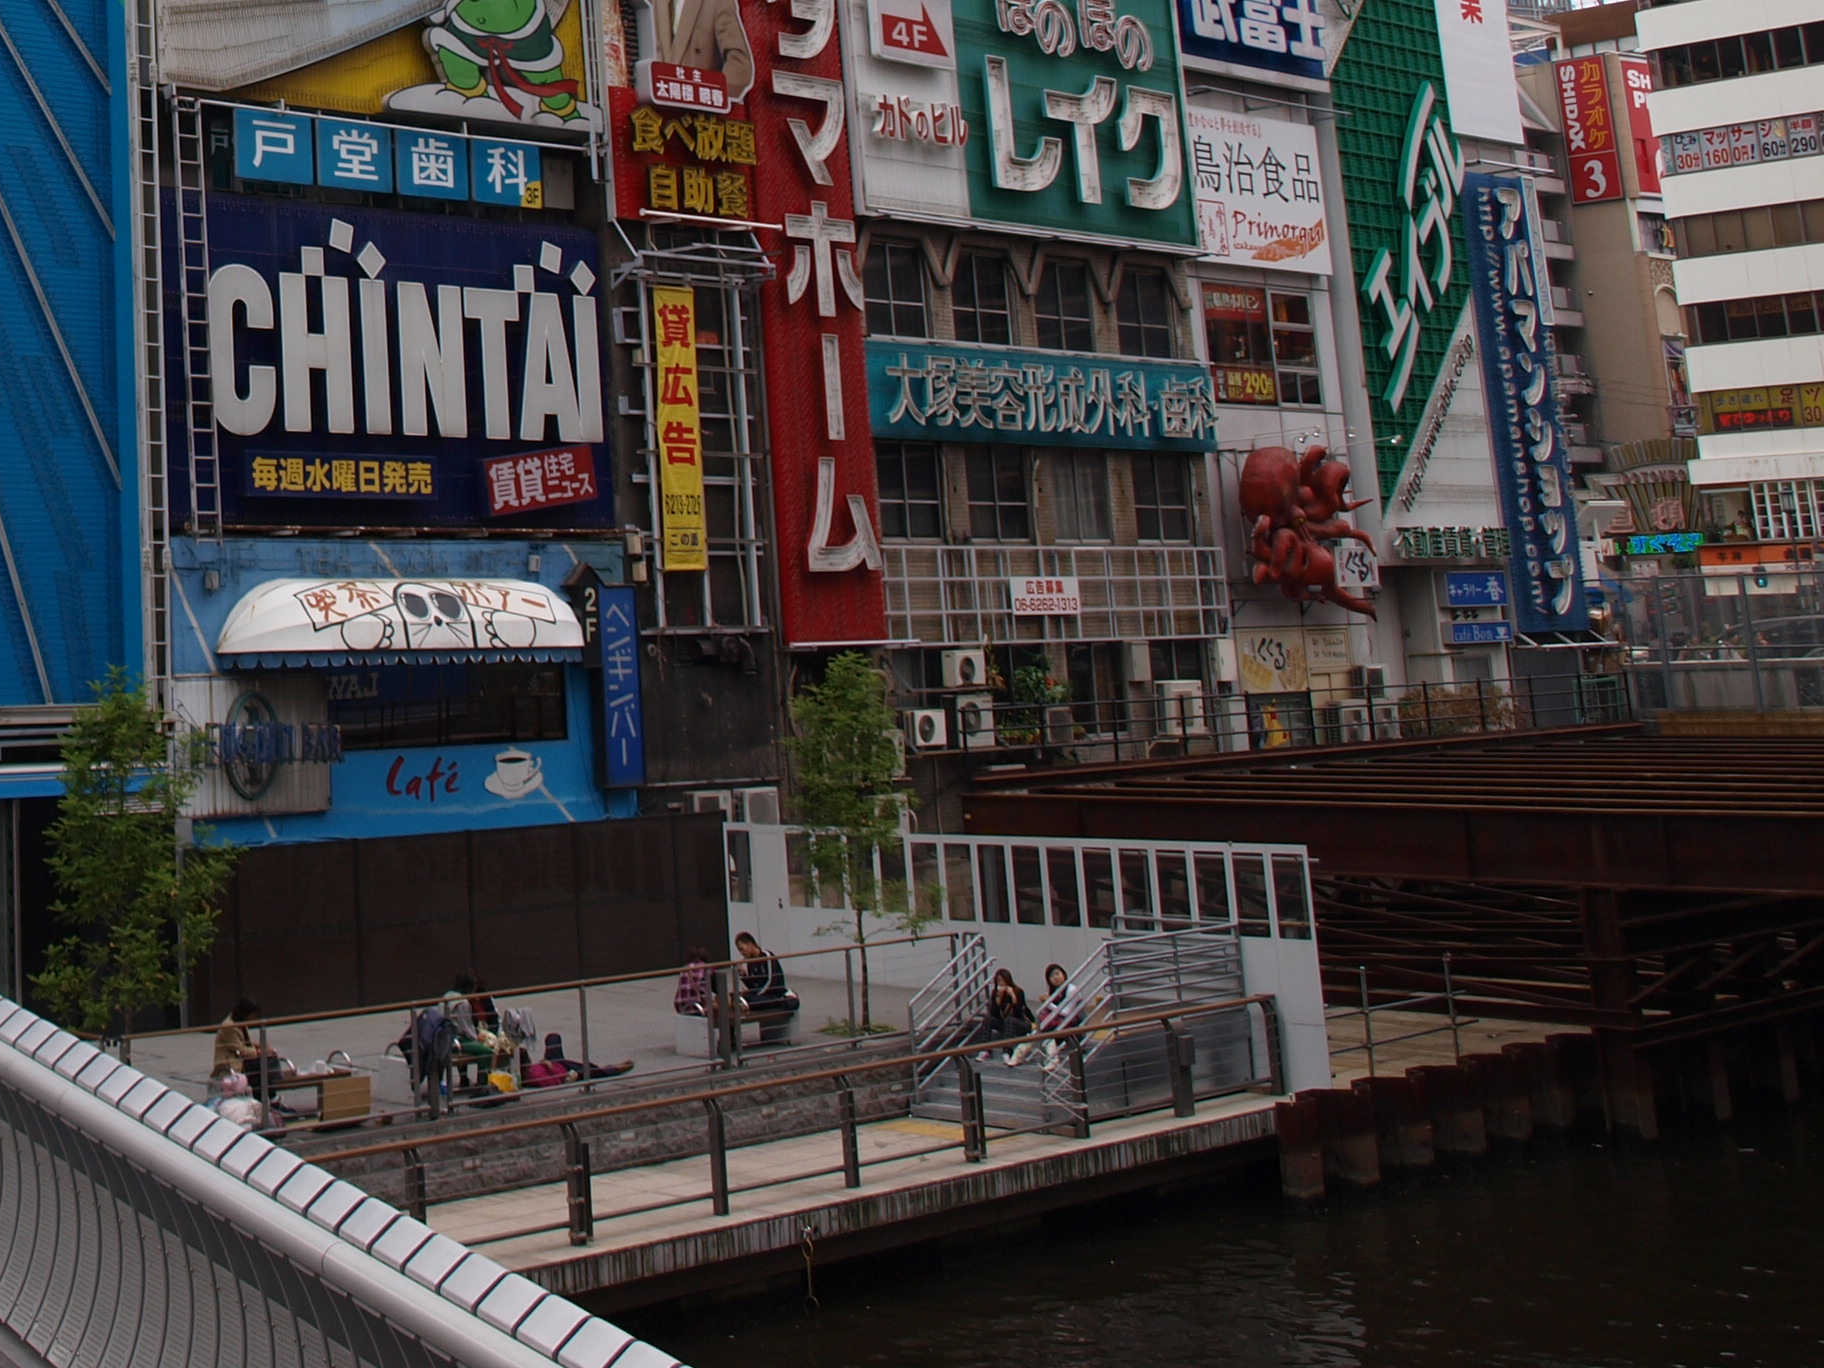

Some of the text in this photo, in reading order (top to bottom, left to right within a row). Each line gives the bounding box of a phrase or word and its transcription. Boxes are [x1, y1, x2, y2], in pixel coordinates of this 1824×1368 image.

[891, 20, 929, 49] 4F
[630, 104, 758, 166] 食べ放題
[874, 94, 969, 148] カドのビル
[981, 53, 1183, 211] レイク
[1560, 64, 1586, 152] SHIDAX
[1578, 61, 1609, 150] カラオケ
[1703, 121, 1773, 146] マッサージ
[251, 119, 528, 196] 戸堂歯科
[648, 162, 749, 219] 自助餐
[1583, 159, 1607, 198] 3
[525, 186, 541, 205] 3F
[1360, 81, 1466, 416] エイブル
[207, 218, 604, 444] CHINTAI
[657, 303, 698, 467] 貸広告
[887, 352, 1220, 441] 大塚美容形成外科・歯科
[1493, 187, 1574, 616] アパマンショップ
[1399, 334, 1476, 514] http://www.able.co.jp
[252, 456, 433, 496] 毎週水曜日発売
[488, 452, 593, 512] 賃貸 住宅 ニュース
[583, 586, 597, 643] 2F
[605, 603, 637, 767] ペンギンバー
[385, 754, 462, 804] Café
